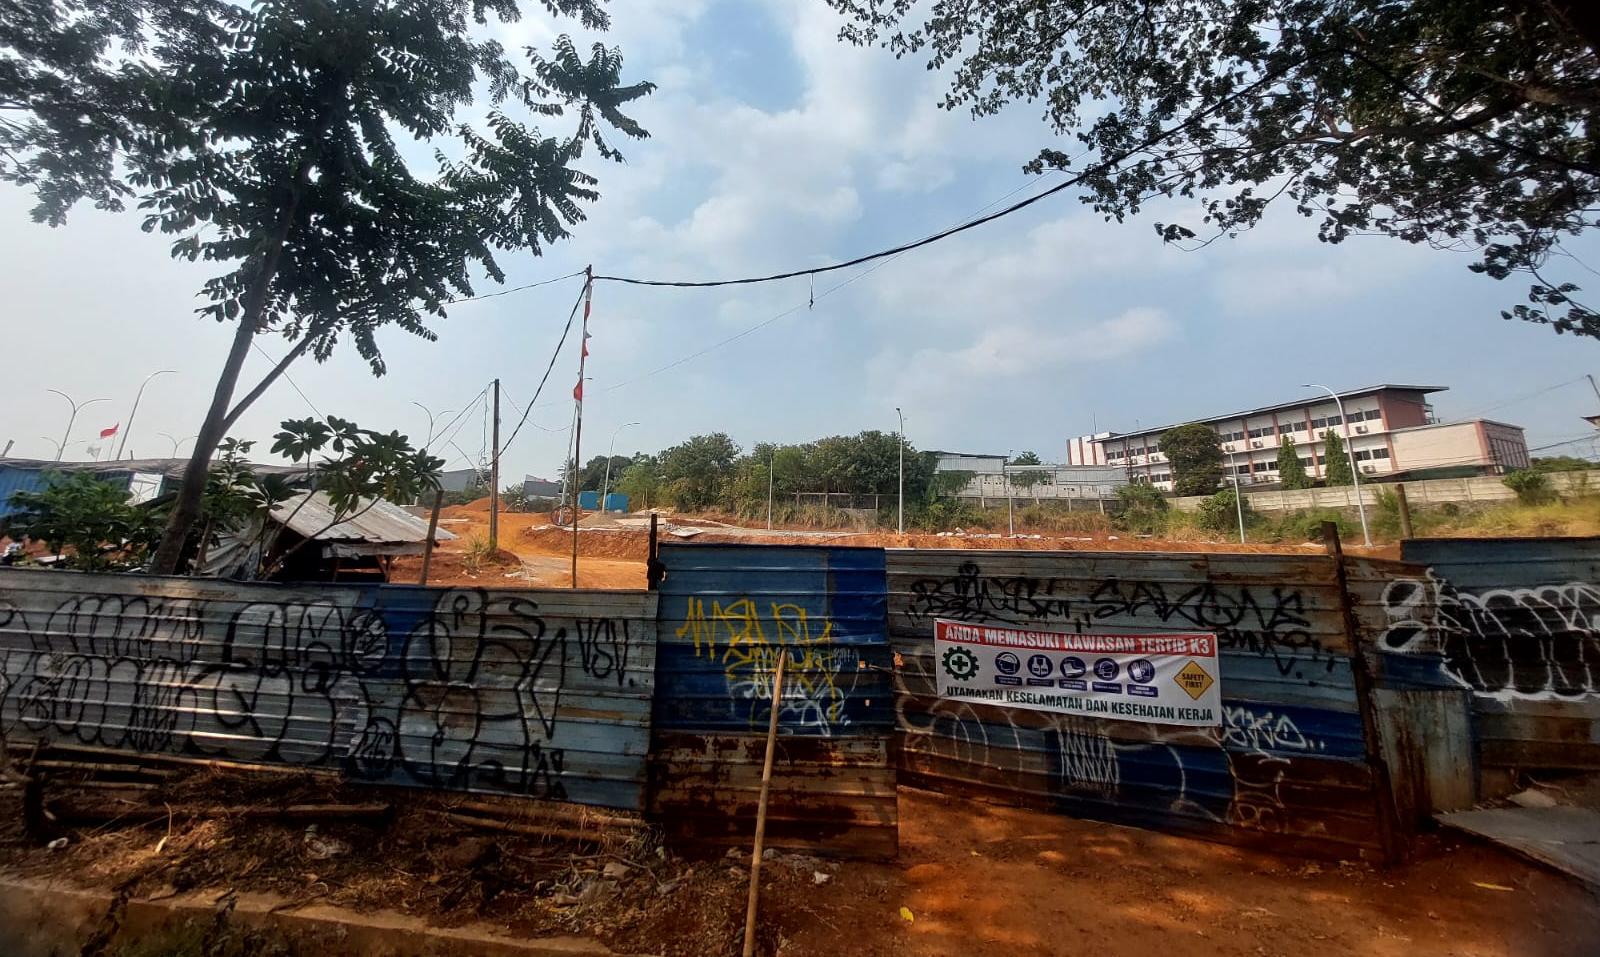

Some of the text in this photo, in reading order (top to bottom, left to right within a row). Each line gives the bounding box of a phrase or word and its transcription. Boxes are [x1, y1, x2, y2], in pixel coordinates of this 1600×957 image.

[945, 625, 1210, 655] ANDA MEMASUKI KAWASAN TERTIB K3
[1181, 672, 1205, 682] SAFETY
[1185, 680, 1202, 689] FIRST
[946, 685, 1214, 721] UTAMAKAN KESELAMATAN DAN KESEHATAN KERJA
